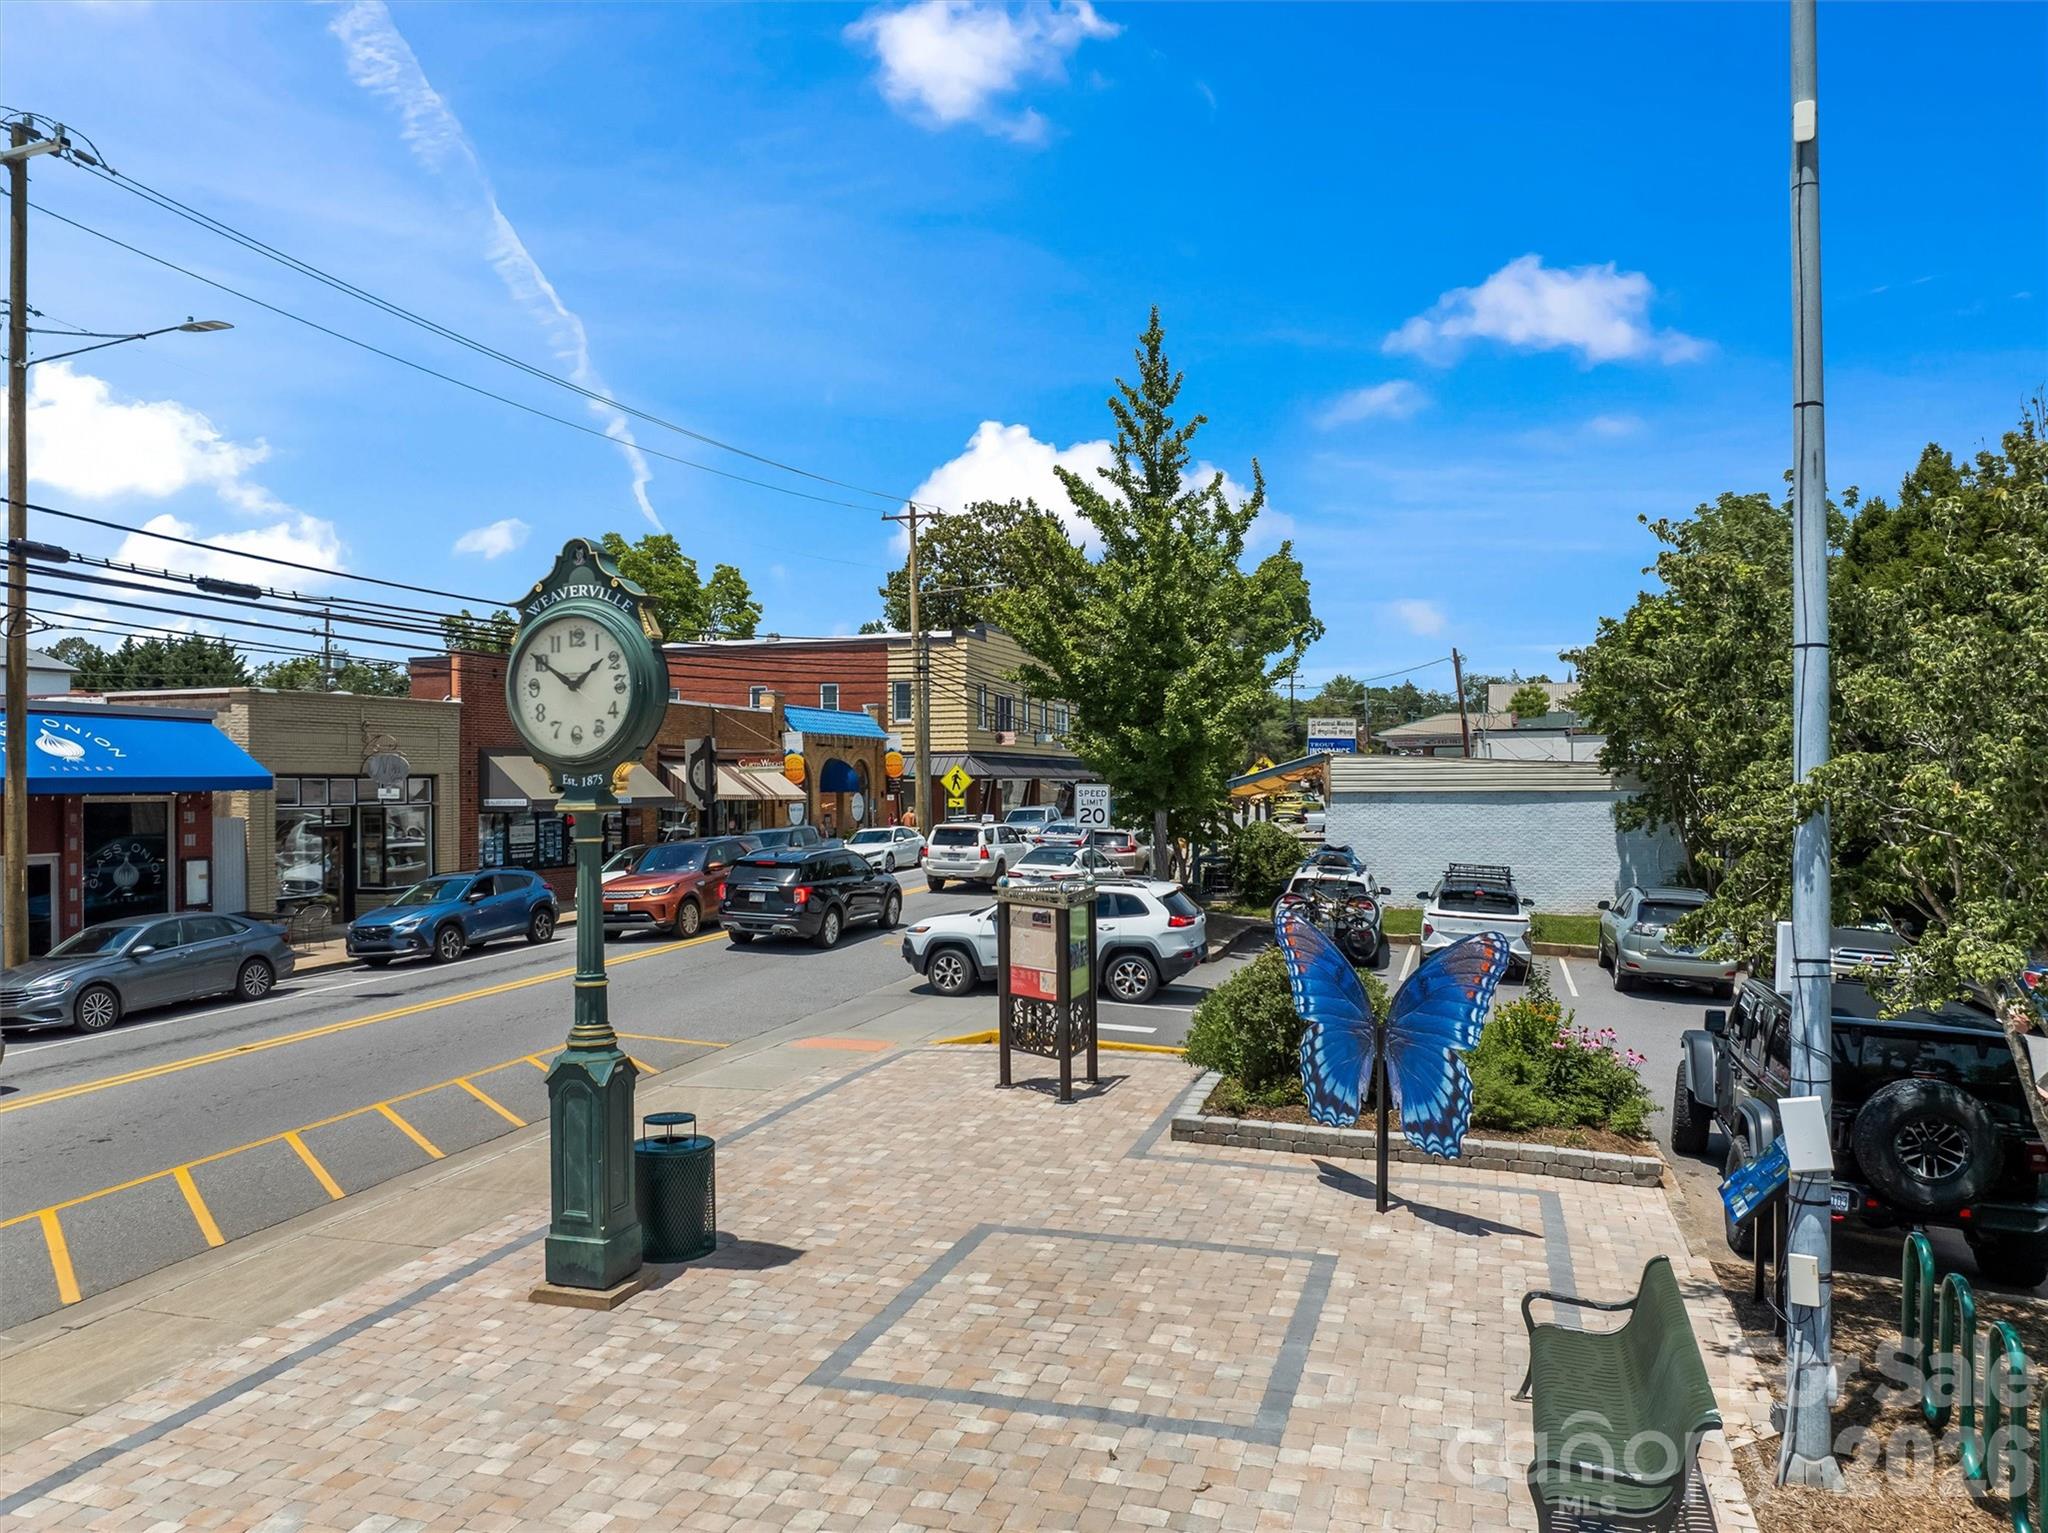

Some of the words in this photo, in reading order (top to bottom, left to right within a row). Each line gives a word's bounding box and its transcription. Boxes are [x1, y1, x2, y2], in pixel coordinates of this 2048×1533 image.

[525, 584, 633, 616] WEAVERVILLE
[569, 628, 586, 648] 12
[595, 633, 599, 651] 1
[608, 650, 620, 670] 2
[528, 678, 541, 698] 9
[613, 674, 627, 694] 3
[535, 703, 546, 723] 8
[607, 700, 619, 719] 4
[42, 718, 127, 758] ONION
[550, 720, 562, 739] 7
[570, 725, 583, 745] 6
[593, 718, 605, 738] 5
[562, 773, 578, 787] Est.
[582, 774, 604, 787] 1875
[1078, 789, 1107, 798] SPEED
[1079, 807, 1106, 824] 20
[89, 843, 122, 889] GLASS
[131, 843, 161, 885] ONION
